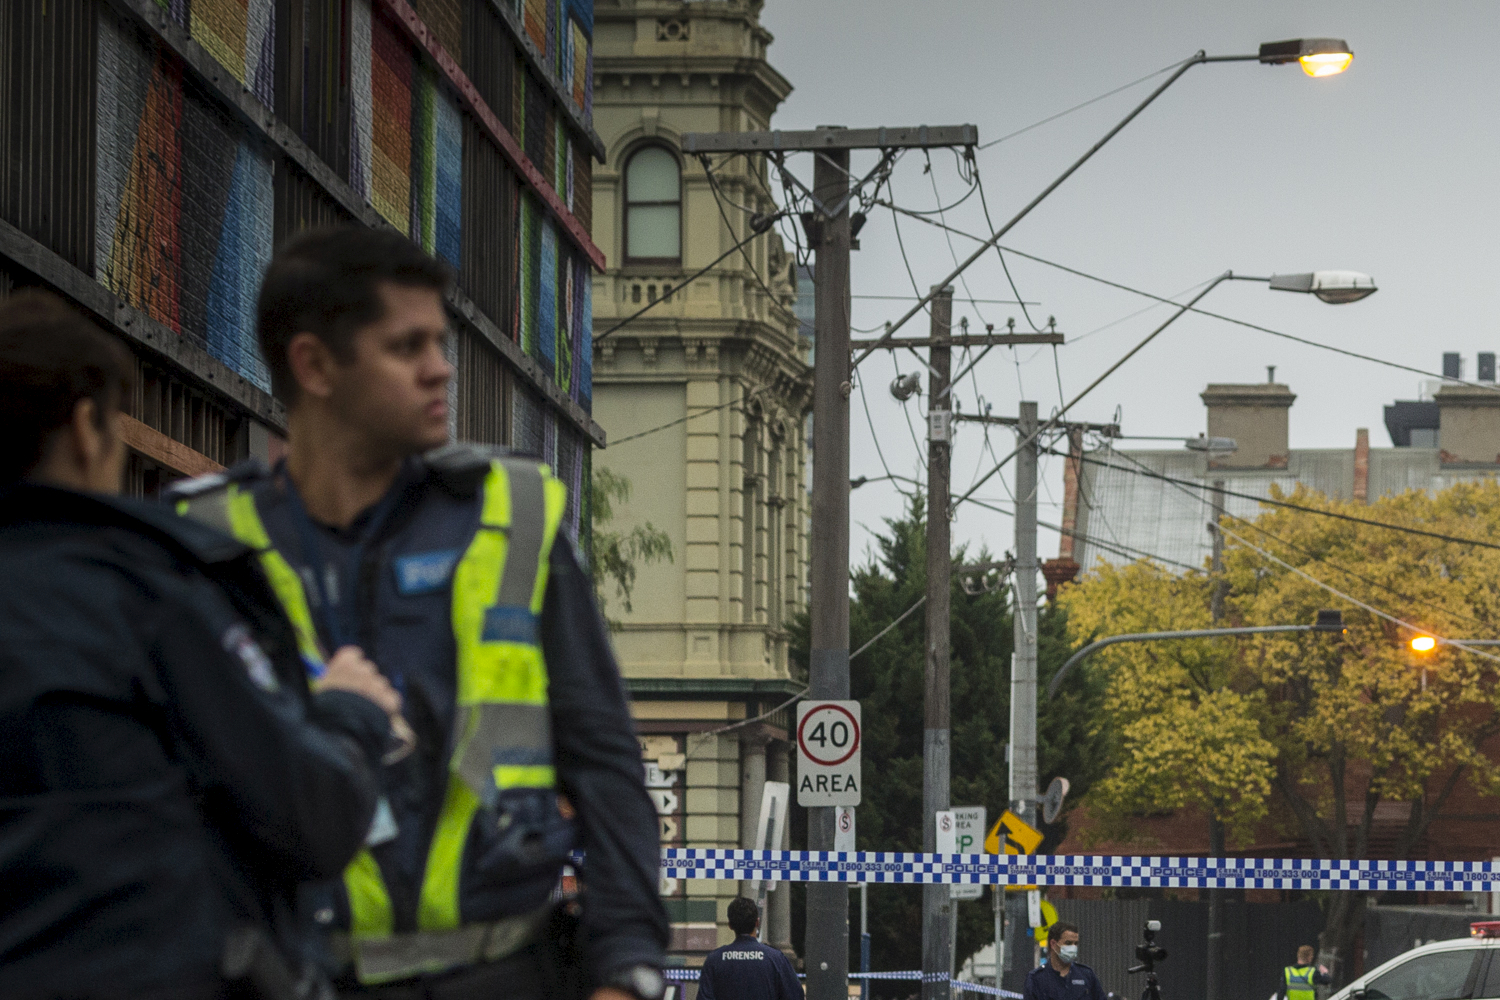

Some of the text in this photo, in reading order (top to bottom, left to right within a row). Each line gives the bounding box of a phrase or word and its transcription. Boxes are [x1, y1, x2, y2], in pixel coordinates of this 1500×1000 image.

[808, 720, 849, 748] 40
[800, 774, 858, 793] AREA
[676, 859, 694, 868] 000
[736, 861, 787, 869] POLICE
[840, 863, 902, 872] 1800 333 000
[945, 864, 995, 873] POLICE
[1048, 866, 1110, 875] 1800 333 000
[1153, 868, 1204, 877] POLICE
[1257, 870, 1319, 879] 1800 333 000
[1362, 871, 1413, 880] POLICE
[1465, 872, 1488, 881] 1800
[722, 950, 764, 961] FORENSIC
